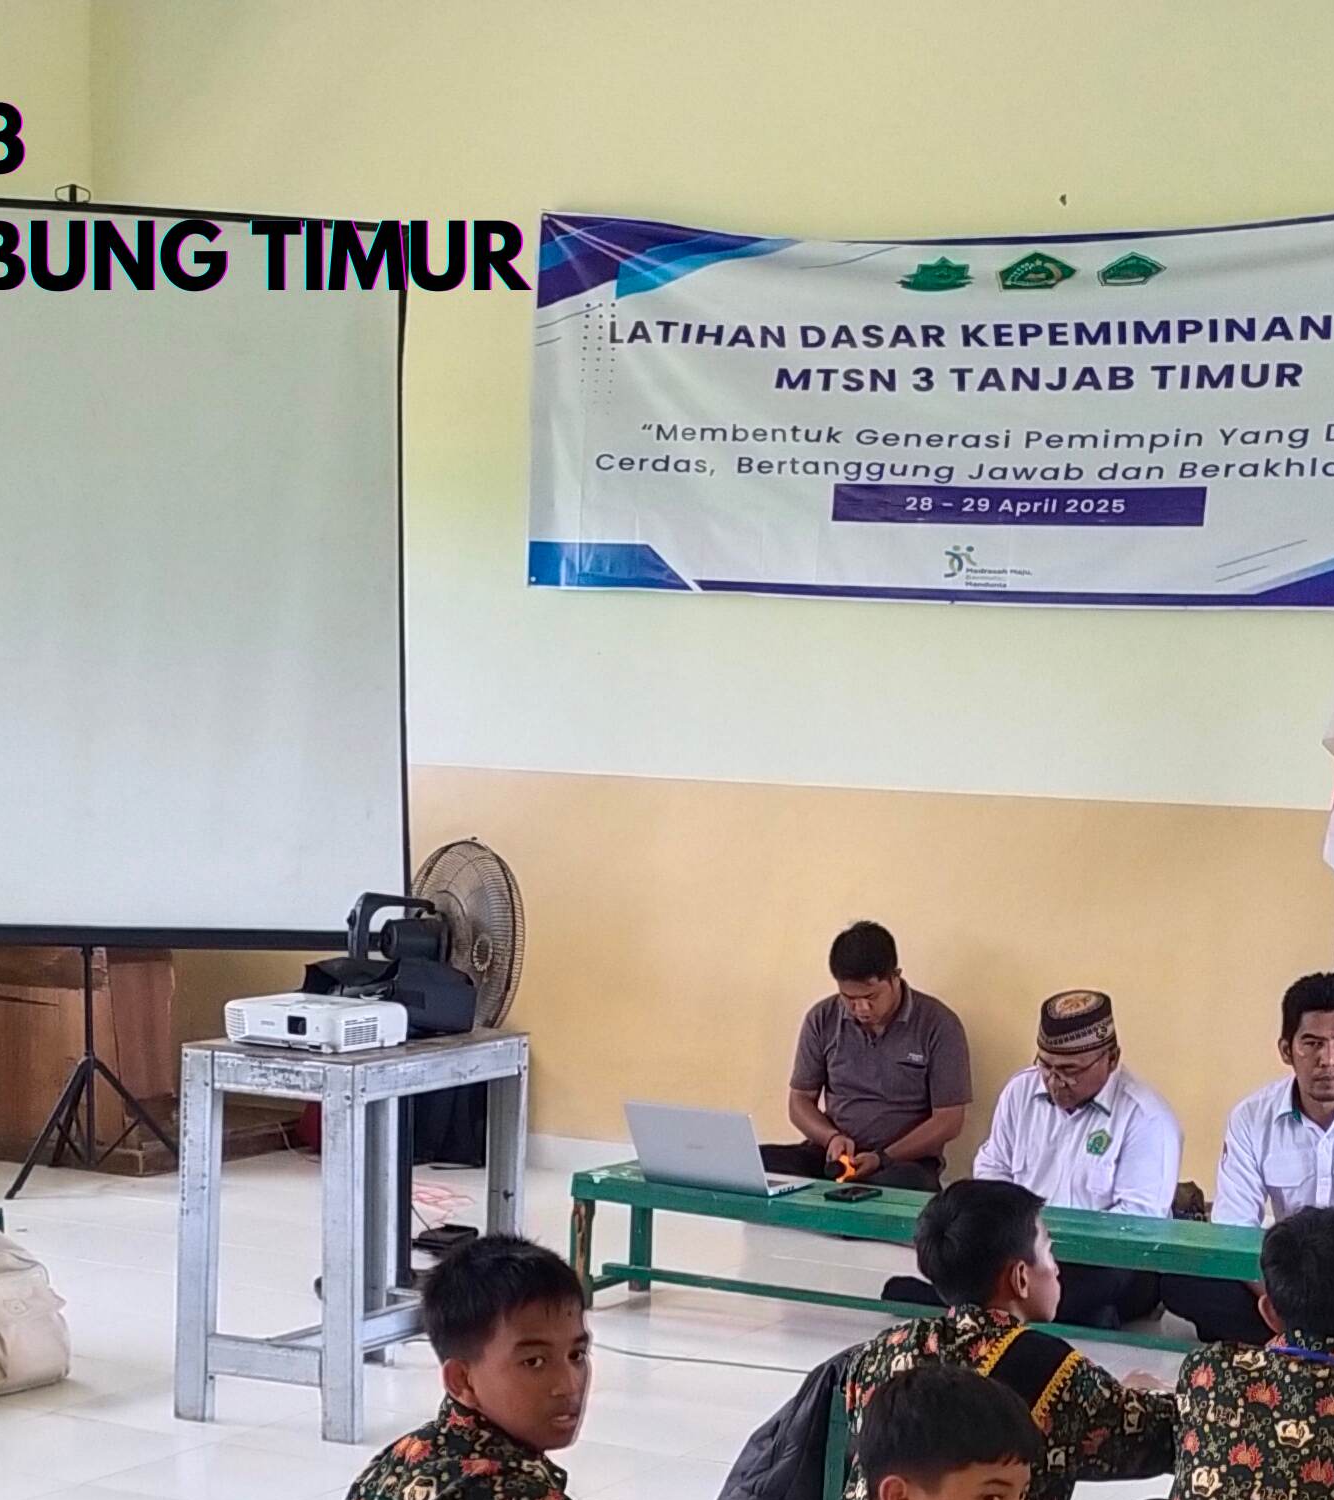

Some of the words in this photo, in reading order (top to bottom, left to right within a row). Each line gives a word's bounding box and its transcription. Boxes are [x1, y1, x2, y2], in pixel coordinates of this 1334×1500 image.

[609, 320, 786, 349] LATIHAN
[800, 323, 947, 349] DASAR
[961, 315, 1333, 348] KEPEMIMPINAN
[774, 366, 898, 393] MTSN
[911, 366, 935, 393] 3
[950, 366, 1135, 393] TANJAB
[1151, 362, 1304, 390] TIMUR
[641, 423, 844, 446] “Membentuk
[856, 428, 1012, 449] Generasi
[1025, 428, 1204, 454] Pemimpin
[1219, 427, 1310, 450] Yang
[595, 453, 717, 477] Cerdas,
[737, 456, 955, 484] Bertanggung
[968, 463, 1084, 482] Jawab
[1098, 461, 1165, 481] dan
[905, 496, 933, 511] 28
[962, 497, 990, 512] 29
[998, 498, 1057, 518] April
[1065, 498, 1126, 513] 2025
